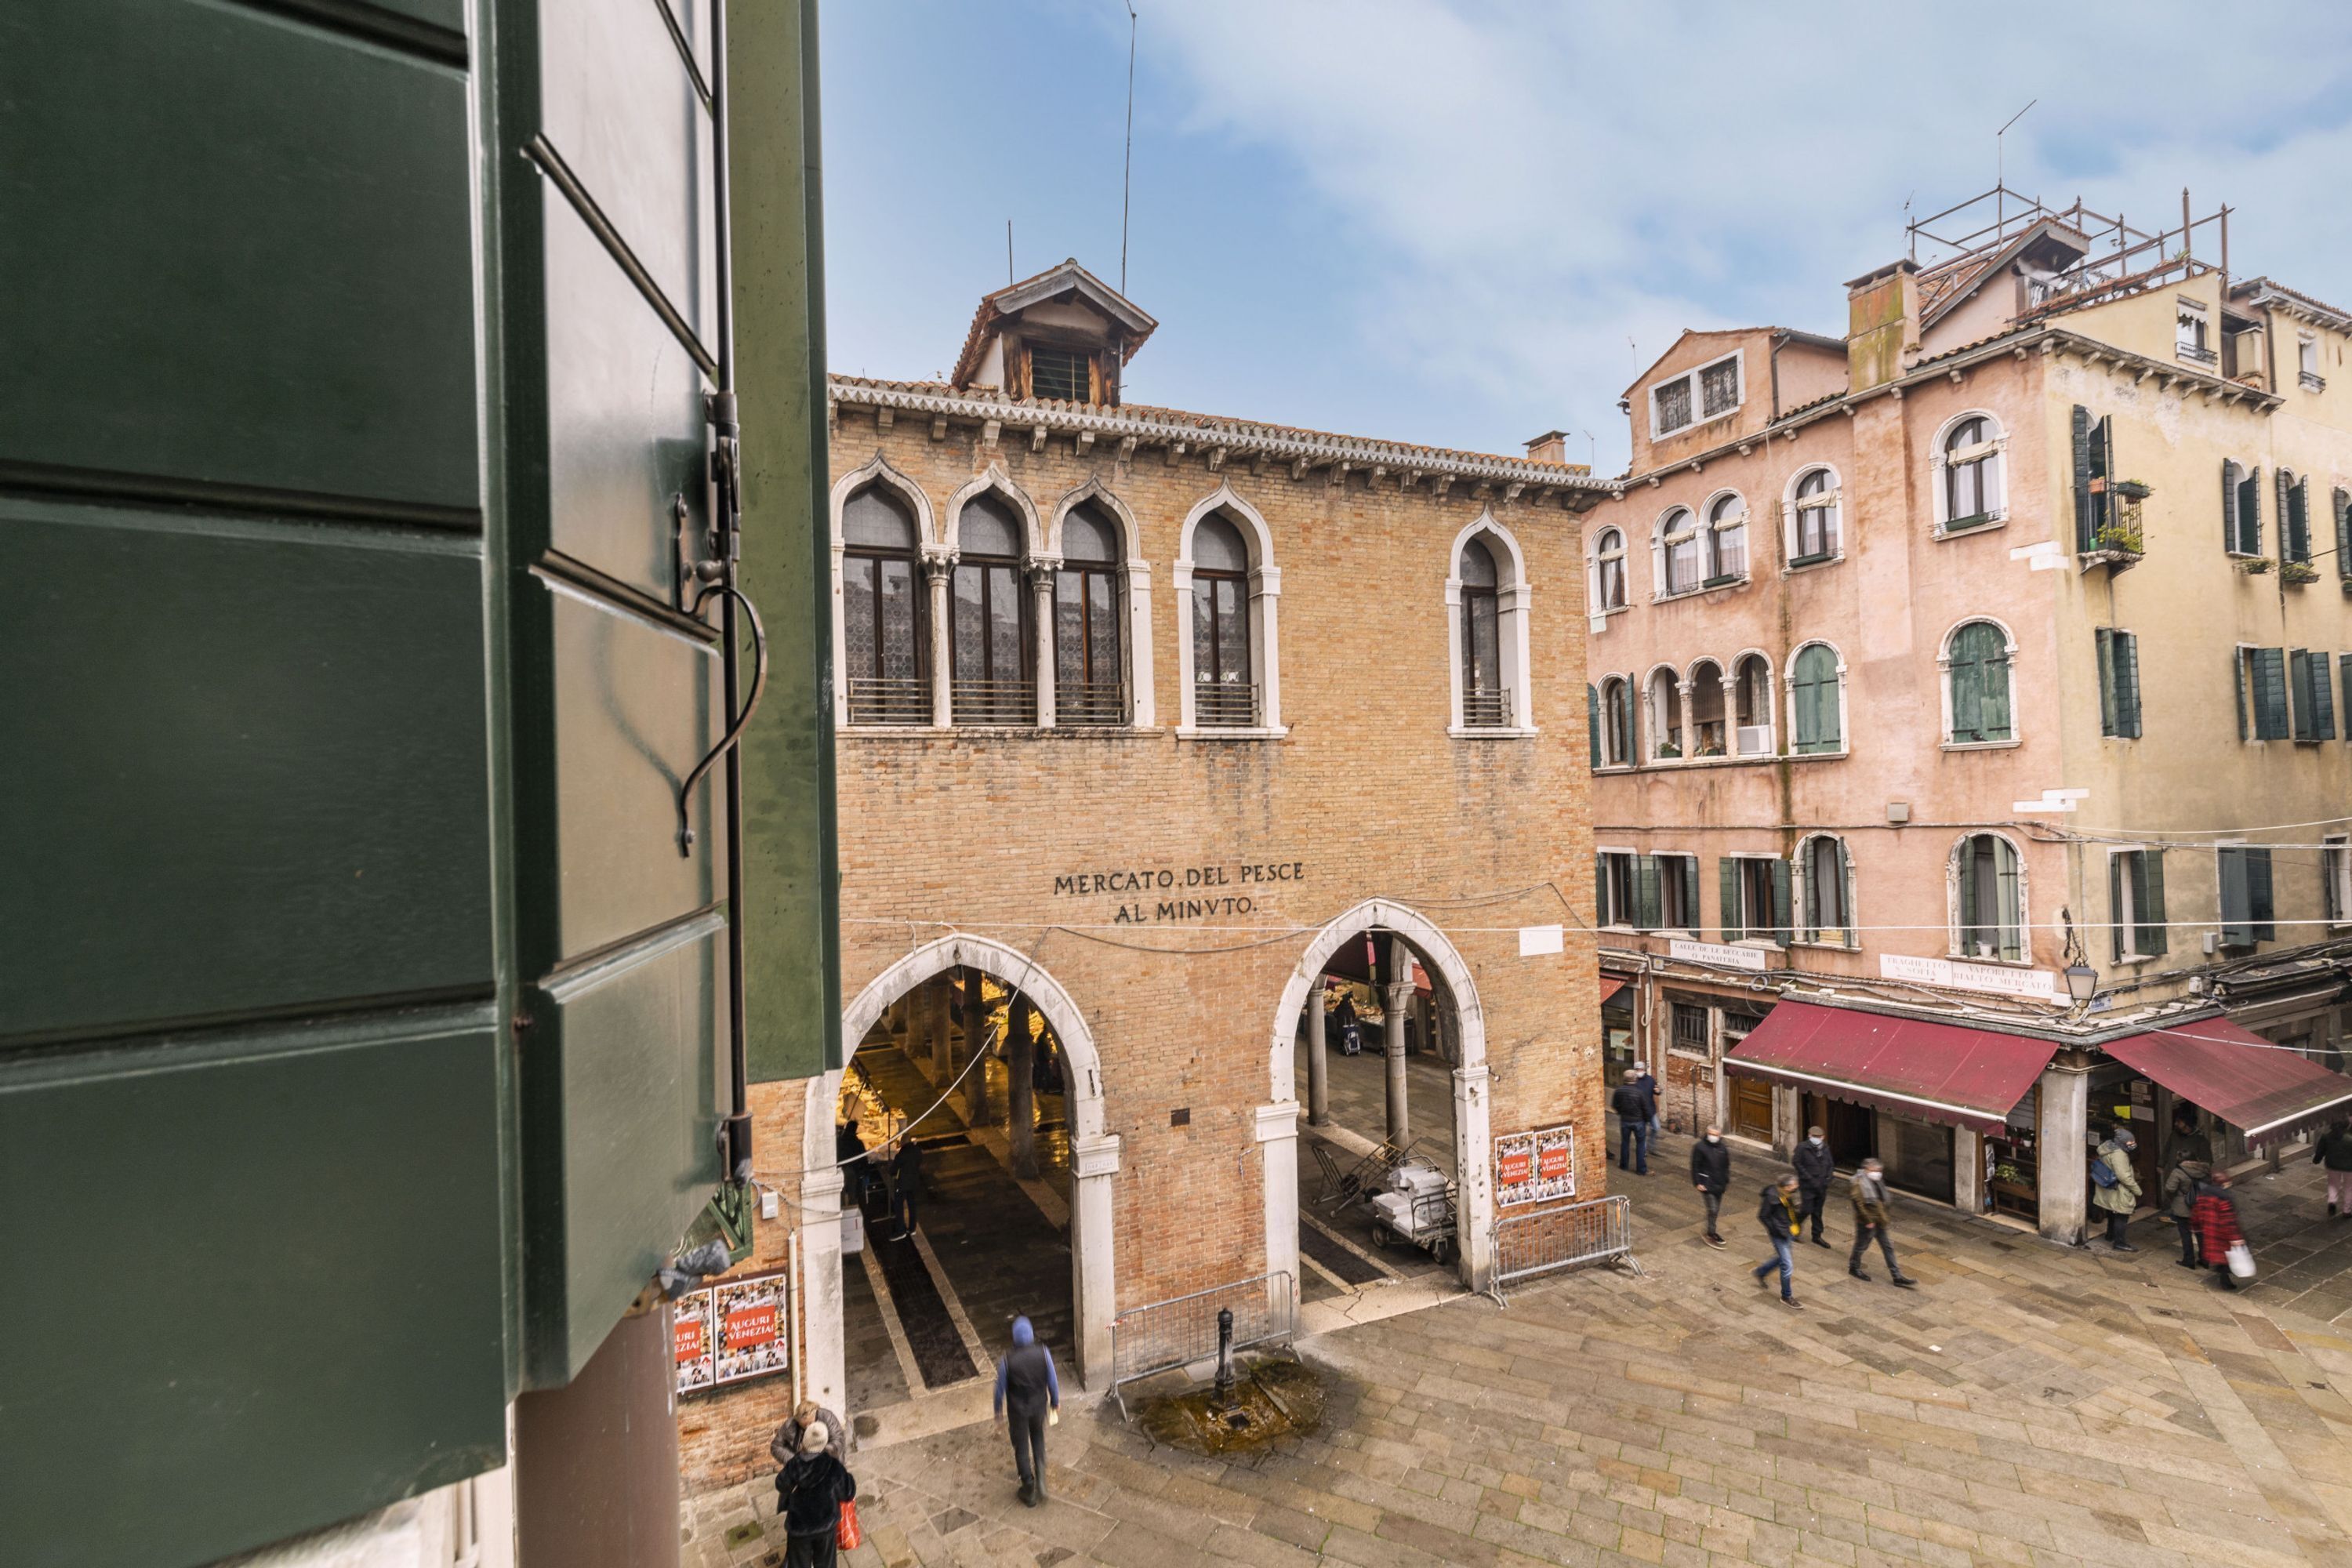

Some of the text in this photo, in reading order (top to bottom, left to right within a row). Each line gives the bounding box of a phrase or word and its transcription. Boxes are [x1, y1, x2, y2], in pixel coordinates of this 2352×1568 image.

[1186, 866, 1229, 886] DEL
[1240, 862, 1305, 883] PESCE
[1113, 904, 1147, 924] AL
[1702, 954, 1740, 964] PANATERIA
[1722, 949, 1757, 959] BECCARIE
[1887, 956, 1947, 970] TRAGHETTO
[1907, 967, 1936, 977] SOFIA
[1969, 965, 2034, 979] VAPORETTO
[1954, 973, 2053, 991] RIALTO MERCATO
[1505, 1161, 1526, 1171] AUGURI
[1543, 1156, 1564, 1166] AUGURI
[729, 1315, 770, 1333] AUGURI
[728, 1324, 775, 1341] VENEZIA!
